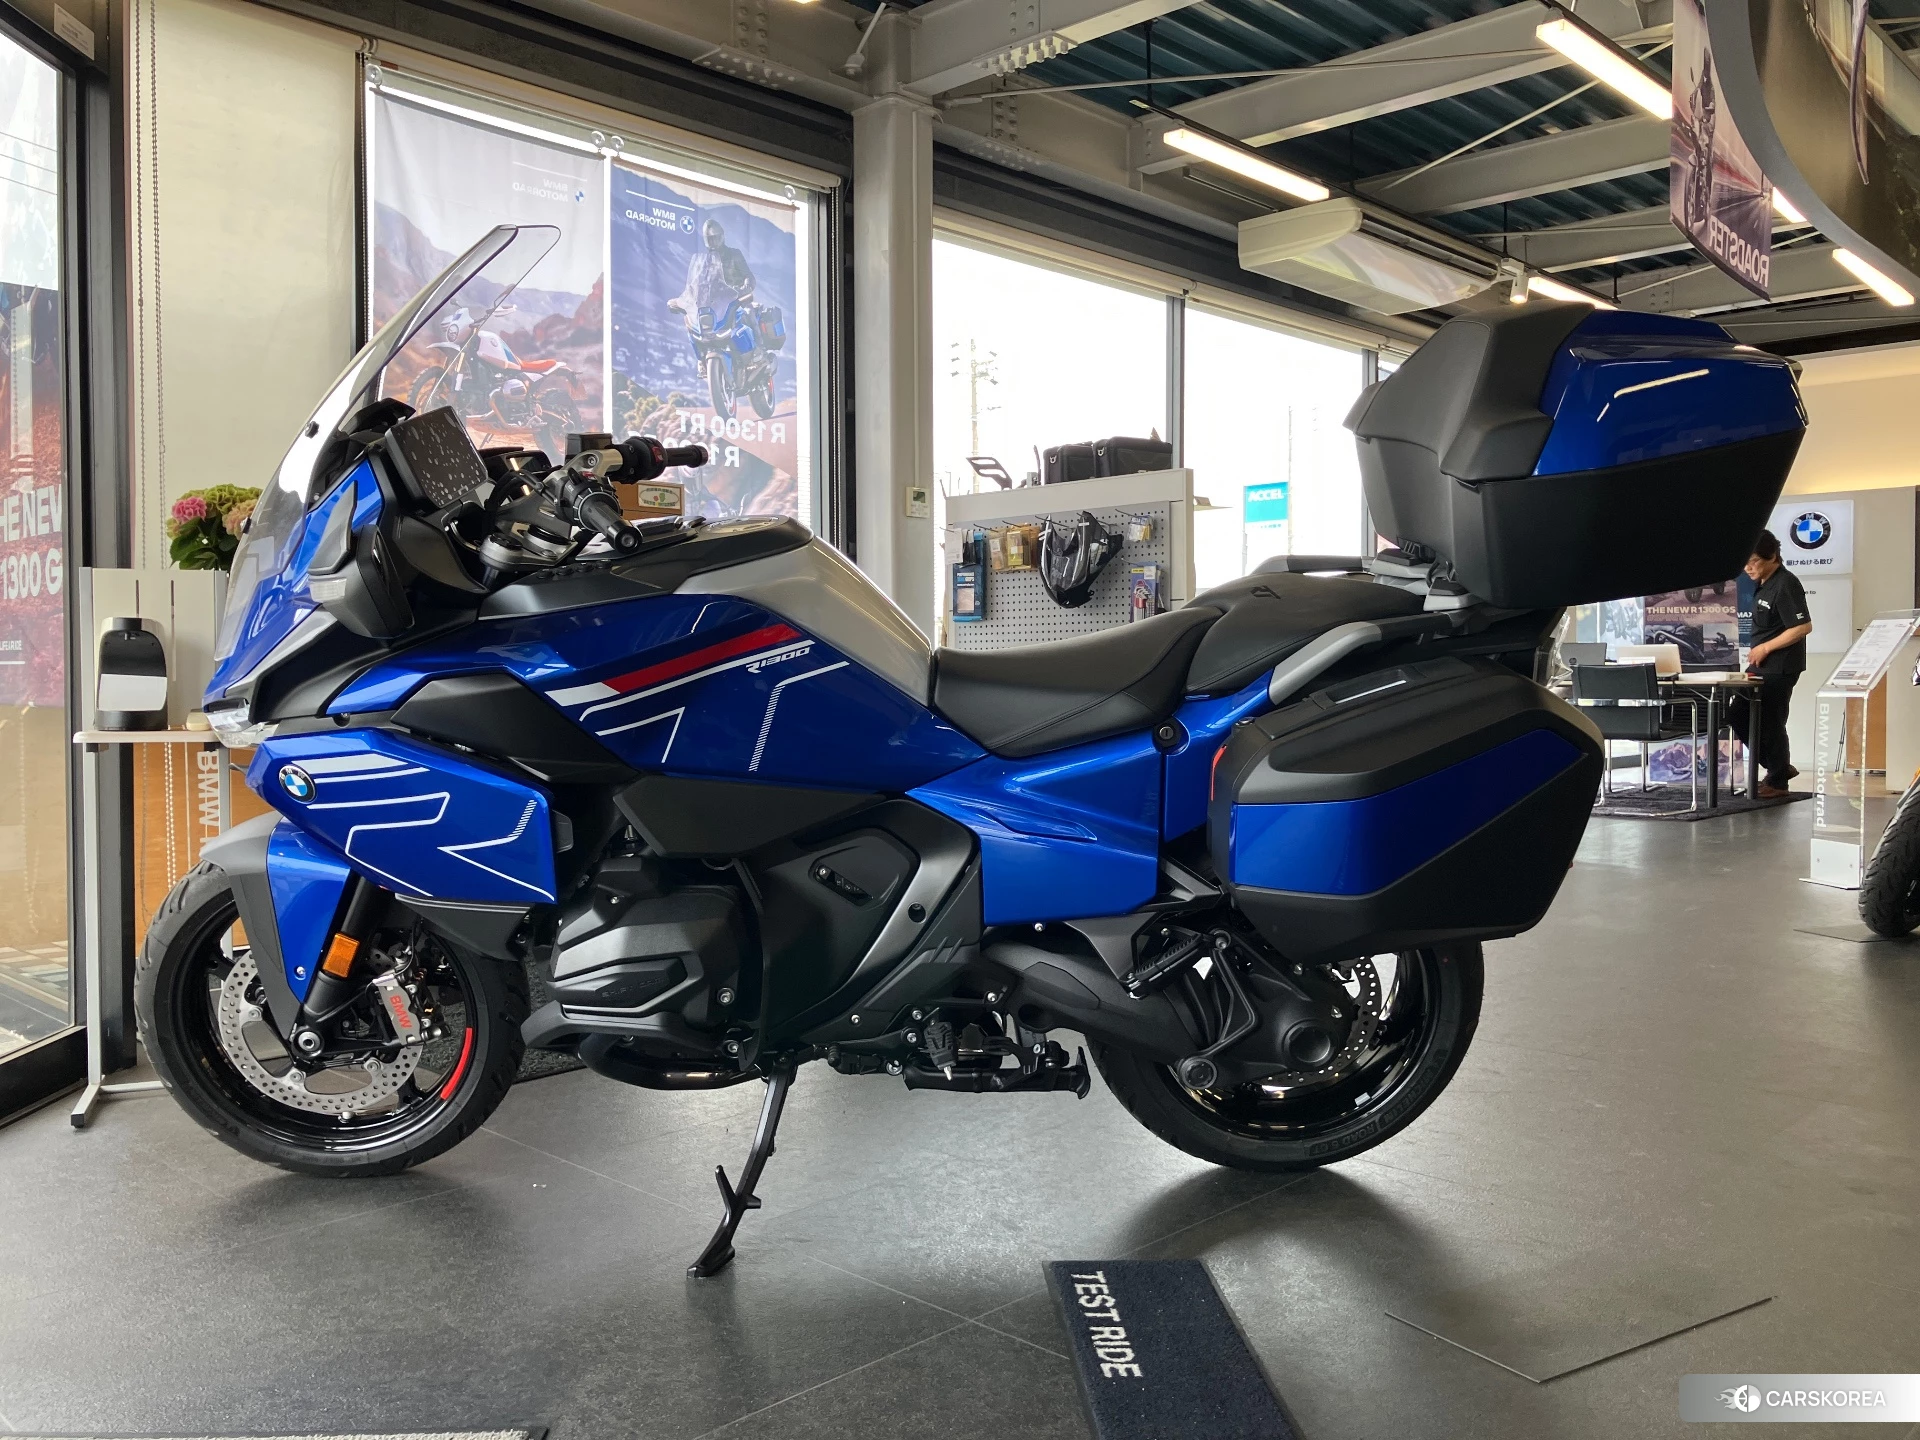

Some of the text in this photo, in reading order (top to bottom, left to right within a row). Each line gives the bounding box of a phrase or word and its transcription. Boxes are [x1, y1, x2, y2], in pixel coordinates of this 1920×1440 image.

[1247, 488, 1285, 502] ACCEL
[0, 552, 41, 600] 1300
[1646, 606, 1736, 614] THE NEW R 1300 GS
[745, 646, 811, 674] R1300
[1816, 703, 1830, 828] BMW Motorrad
[197, 749, 220, 827] BMW
[390, 995, 413, 1028] BMW
[1070, 1270, 1143, 1378] TEST RIDE
